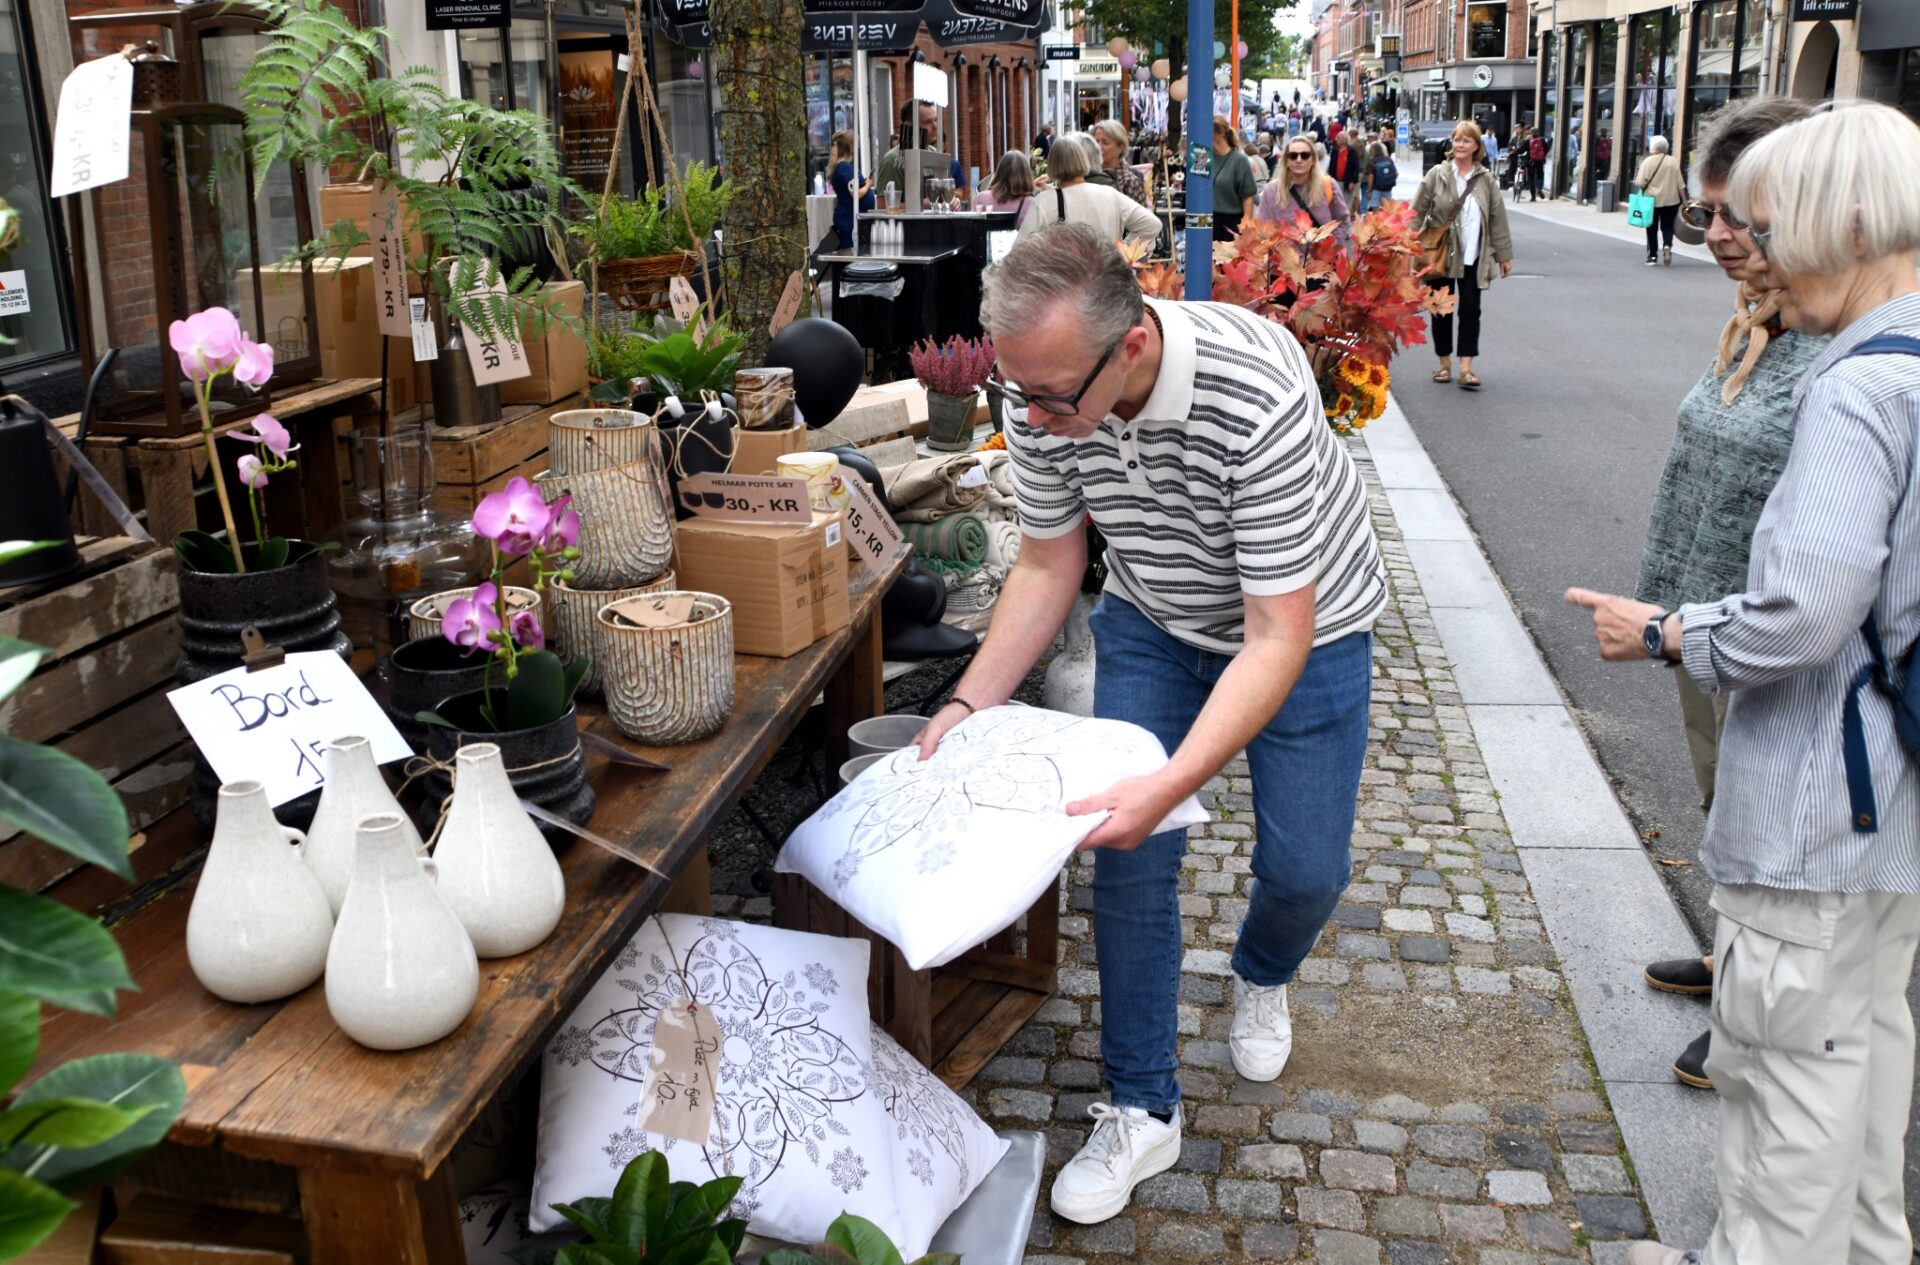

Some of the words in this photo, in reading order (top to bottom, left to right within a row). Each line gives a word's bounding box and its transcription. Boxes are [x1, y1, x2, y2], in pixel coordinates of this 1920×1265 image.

[455, 4, 481, 12] REMOVAL
[1818, 0, 1849, 10] clinic
[1079, 62, 1118, 73] GUNDTOFT
[72, 153, 92, 186] KR
[379, 234, 390, 285] 179,-
[384, 290, 394, 318] KR
[480, 341, 501, 369] KR
[711, 479, 746, 488] HELMAR
[748, 480, 774, 488] POTTE
[777, 481, 795, 489] SÆT
[725, 498, 765, 513] 30,-
[769, 499, 800, 512] KR
[852, 479, 871, 504] CARMEN
[870, 502, 884, 519] STAGE
[881, 517, 899, 541] YELLOW
[847, 507, 867, 535] 15,-
[865, 532, 884, 558] KR
[210, 669, 334, 732] Bord
